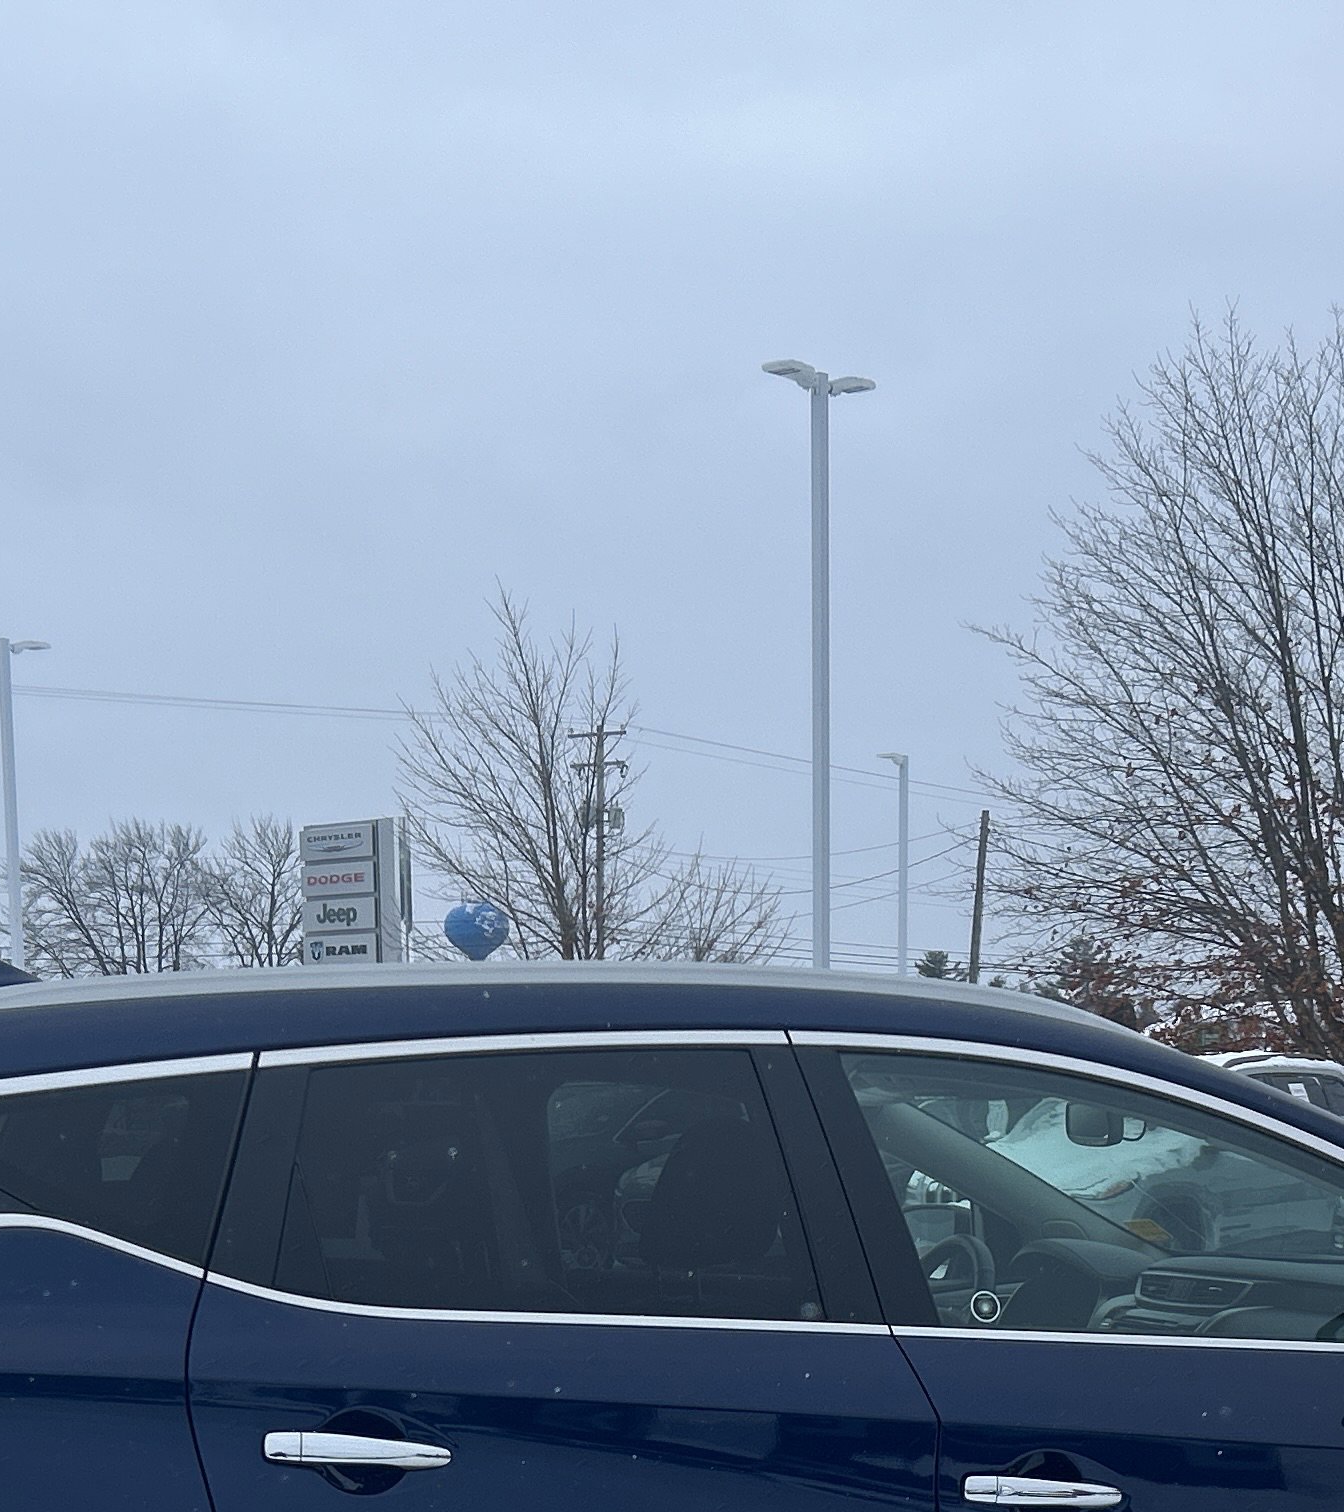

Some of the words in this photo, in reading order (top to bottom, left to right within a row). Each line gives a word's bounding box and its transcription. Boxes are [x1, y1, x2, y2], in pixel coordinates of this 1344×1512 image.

[306, 832, 362, 844] CHRYSLER
[306, 872, 366, 887] DODGE
[316, 903, 358, 927] Jeep
[325, 944, 368, 957] RAM
